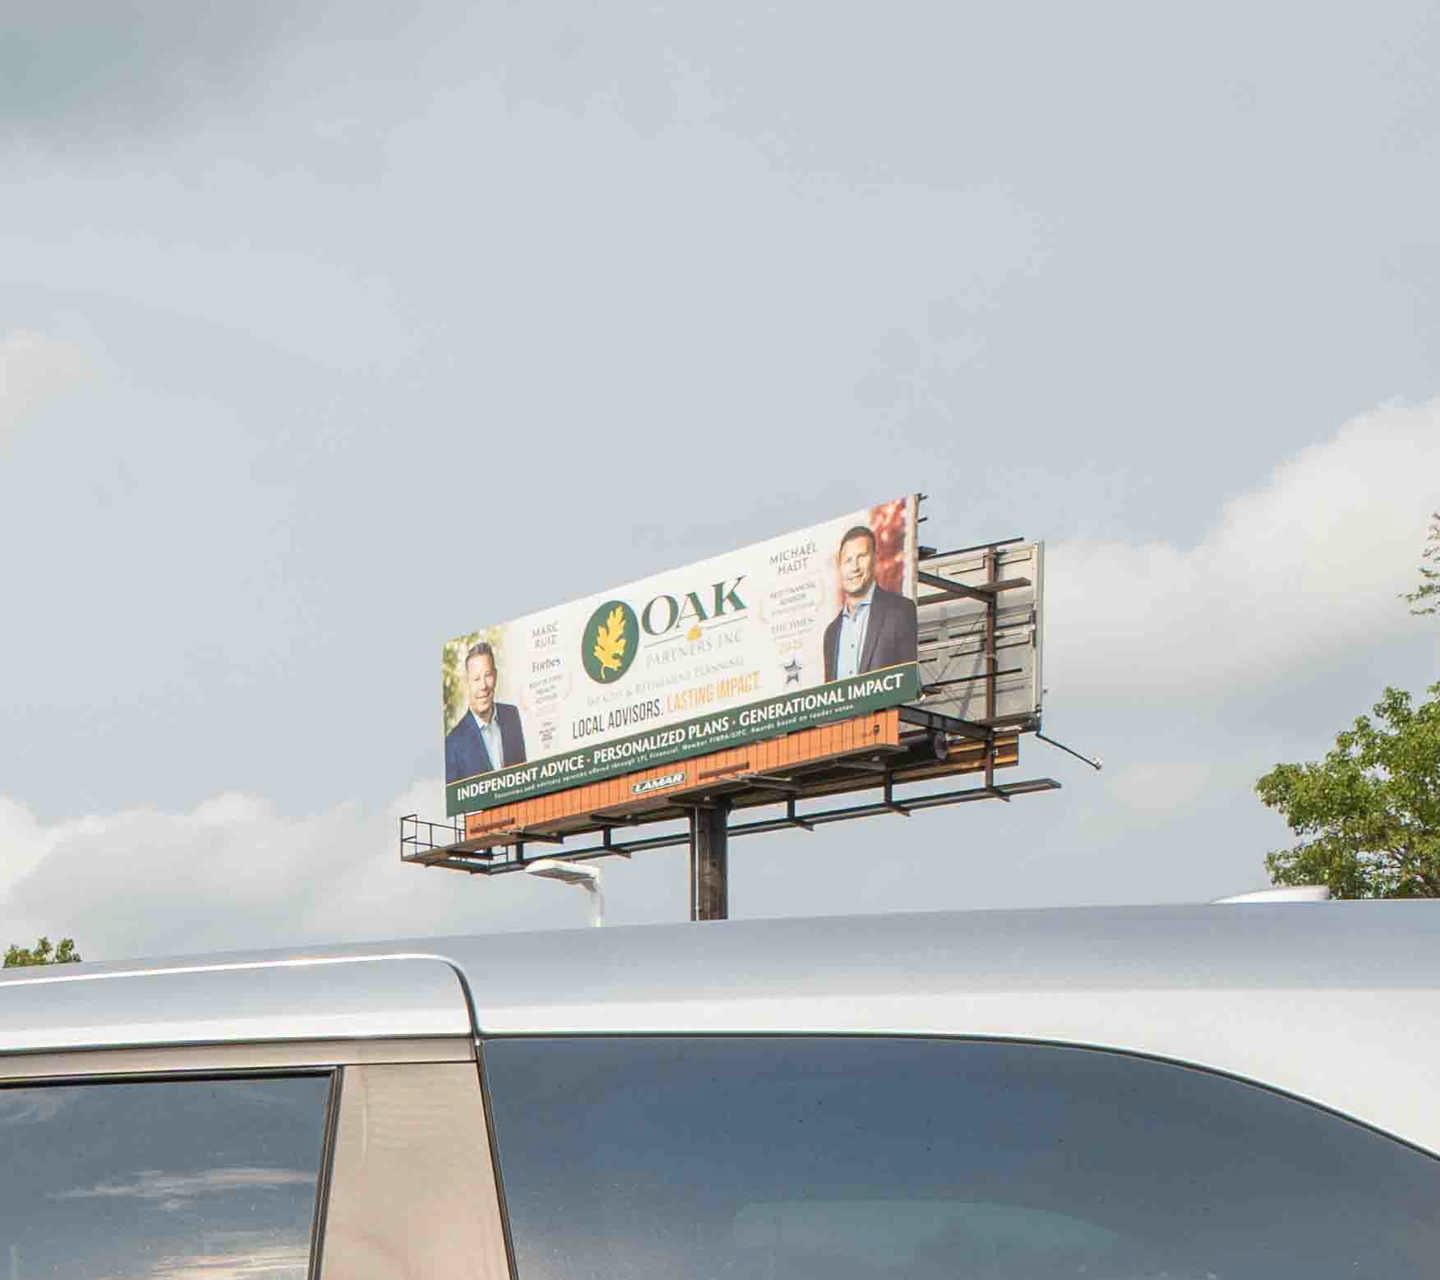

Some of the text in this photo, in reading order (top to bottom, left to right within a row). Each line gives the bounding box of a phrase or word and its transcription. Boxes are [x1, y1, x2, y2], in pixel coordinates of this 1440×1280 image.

[641, 575, 747, 636] OAK
[456, 672, 904, 801] INDEPENDENT ADVICE PERSONALIZED PLANS GENERATIONAL IMPACT
[572, 719, 605, 740] LOCAL
[607, 698, 664, 730] ADVISORS.
[666, 681, 714, 713] LASTING
[717, 670, 761, 699] IMPACT
[634, 773, 685, 792] LAMAR
